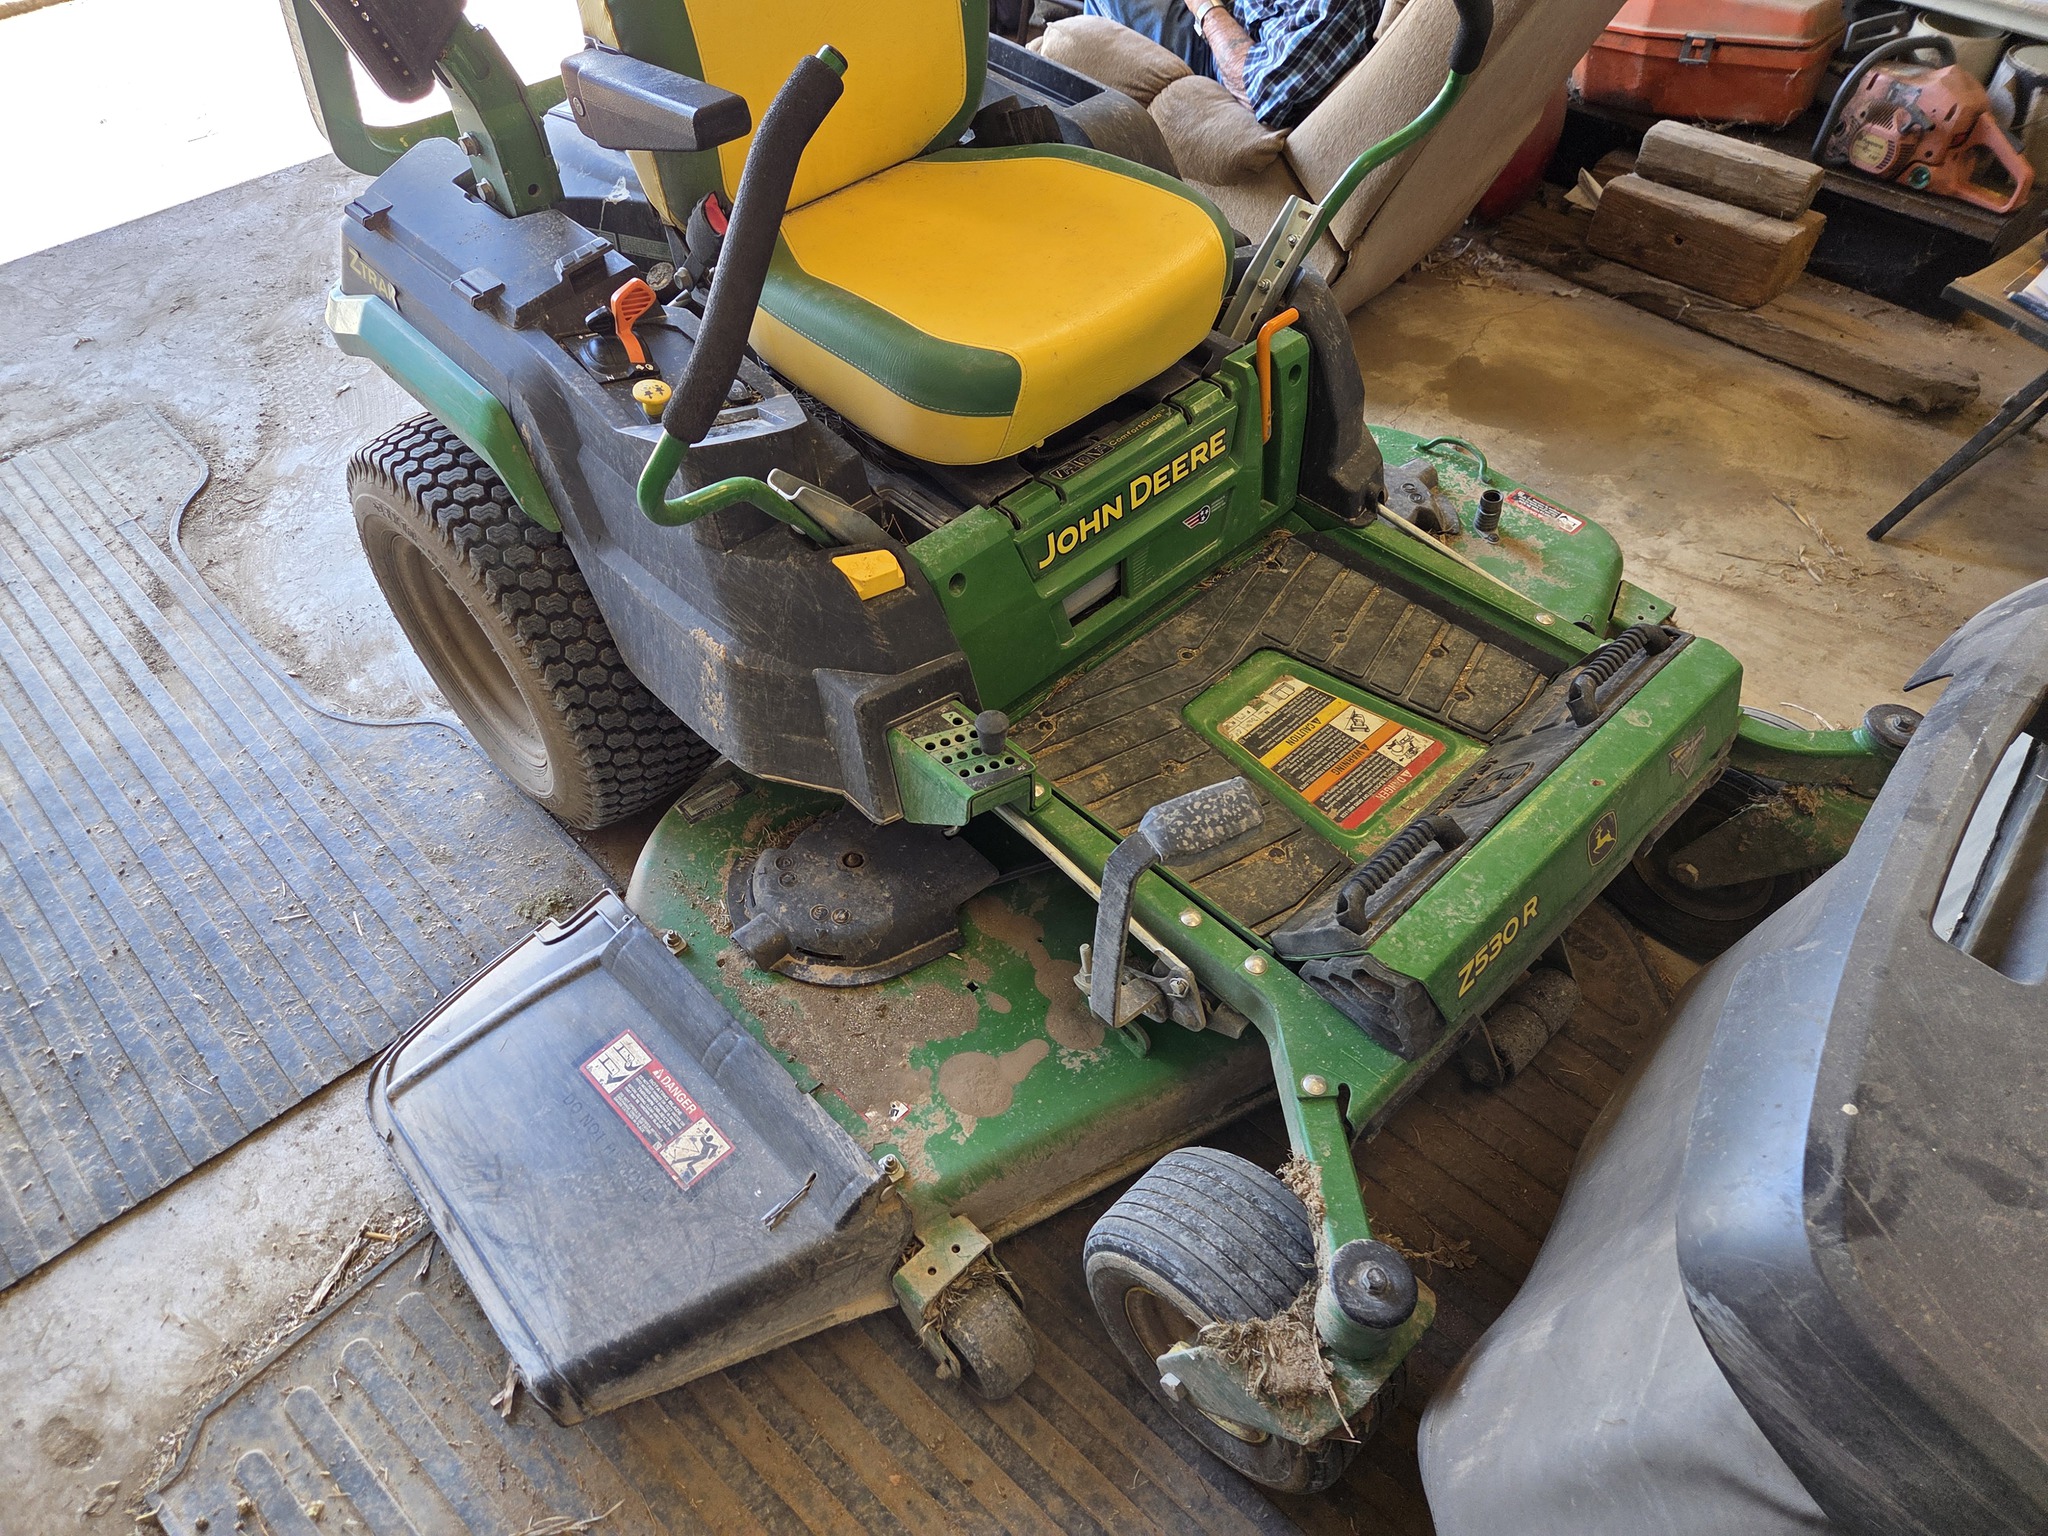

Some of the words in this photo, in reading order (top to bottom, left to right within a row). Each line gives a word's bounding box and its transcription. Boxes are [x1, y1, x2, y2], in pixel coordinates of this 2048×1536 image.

[1039, 494, 1122, 570] JOHN
[1130, 428, 1226, 510] DEERE
[1285, 721, 1315, 746] CAUTION
[1330, 748, 1364, 777] WARNING
[1374, 774, 1405, 802] DANGER
[1458, 917, 1519, 998] Z530
[1523, 895, 1539, 927] R
[660, 1075, 697, 1114] DANGER
